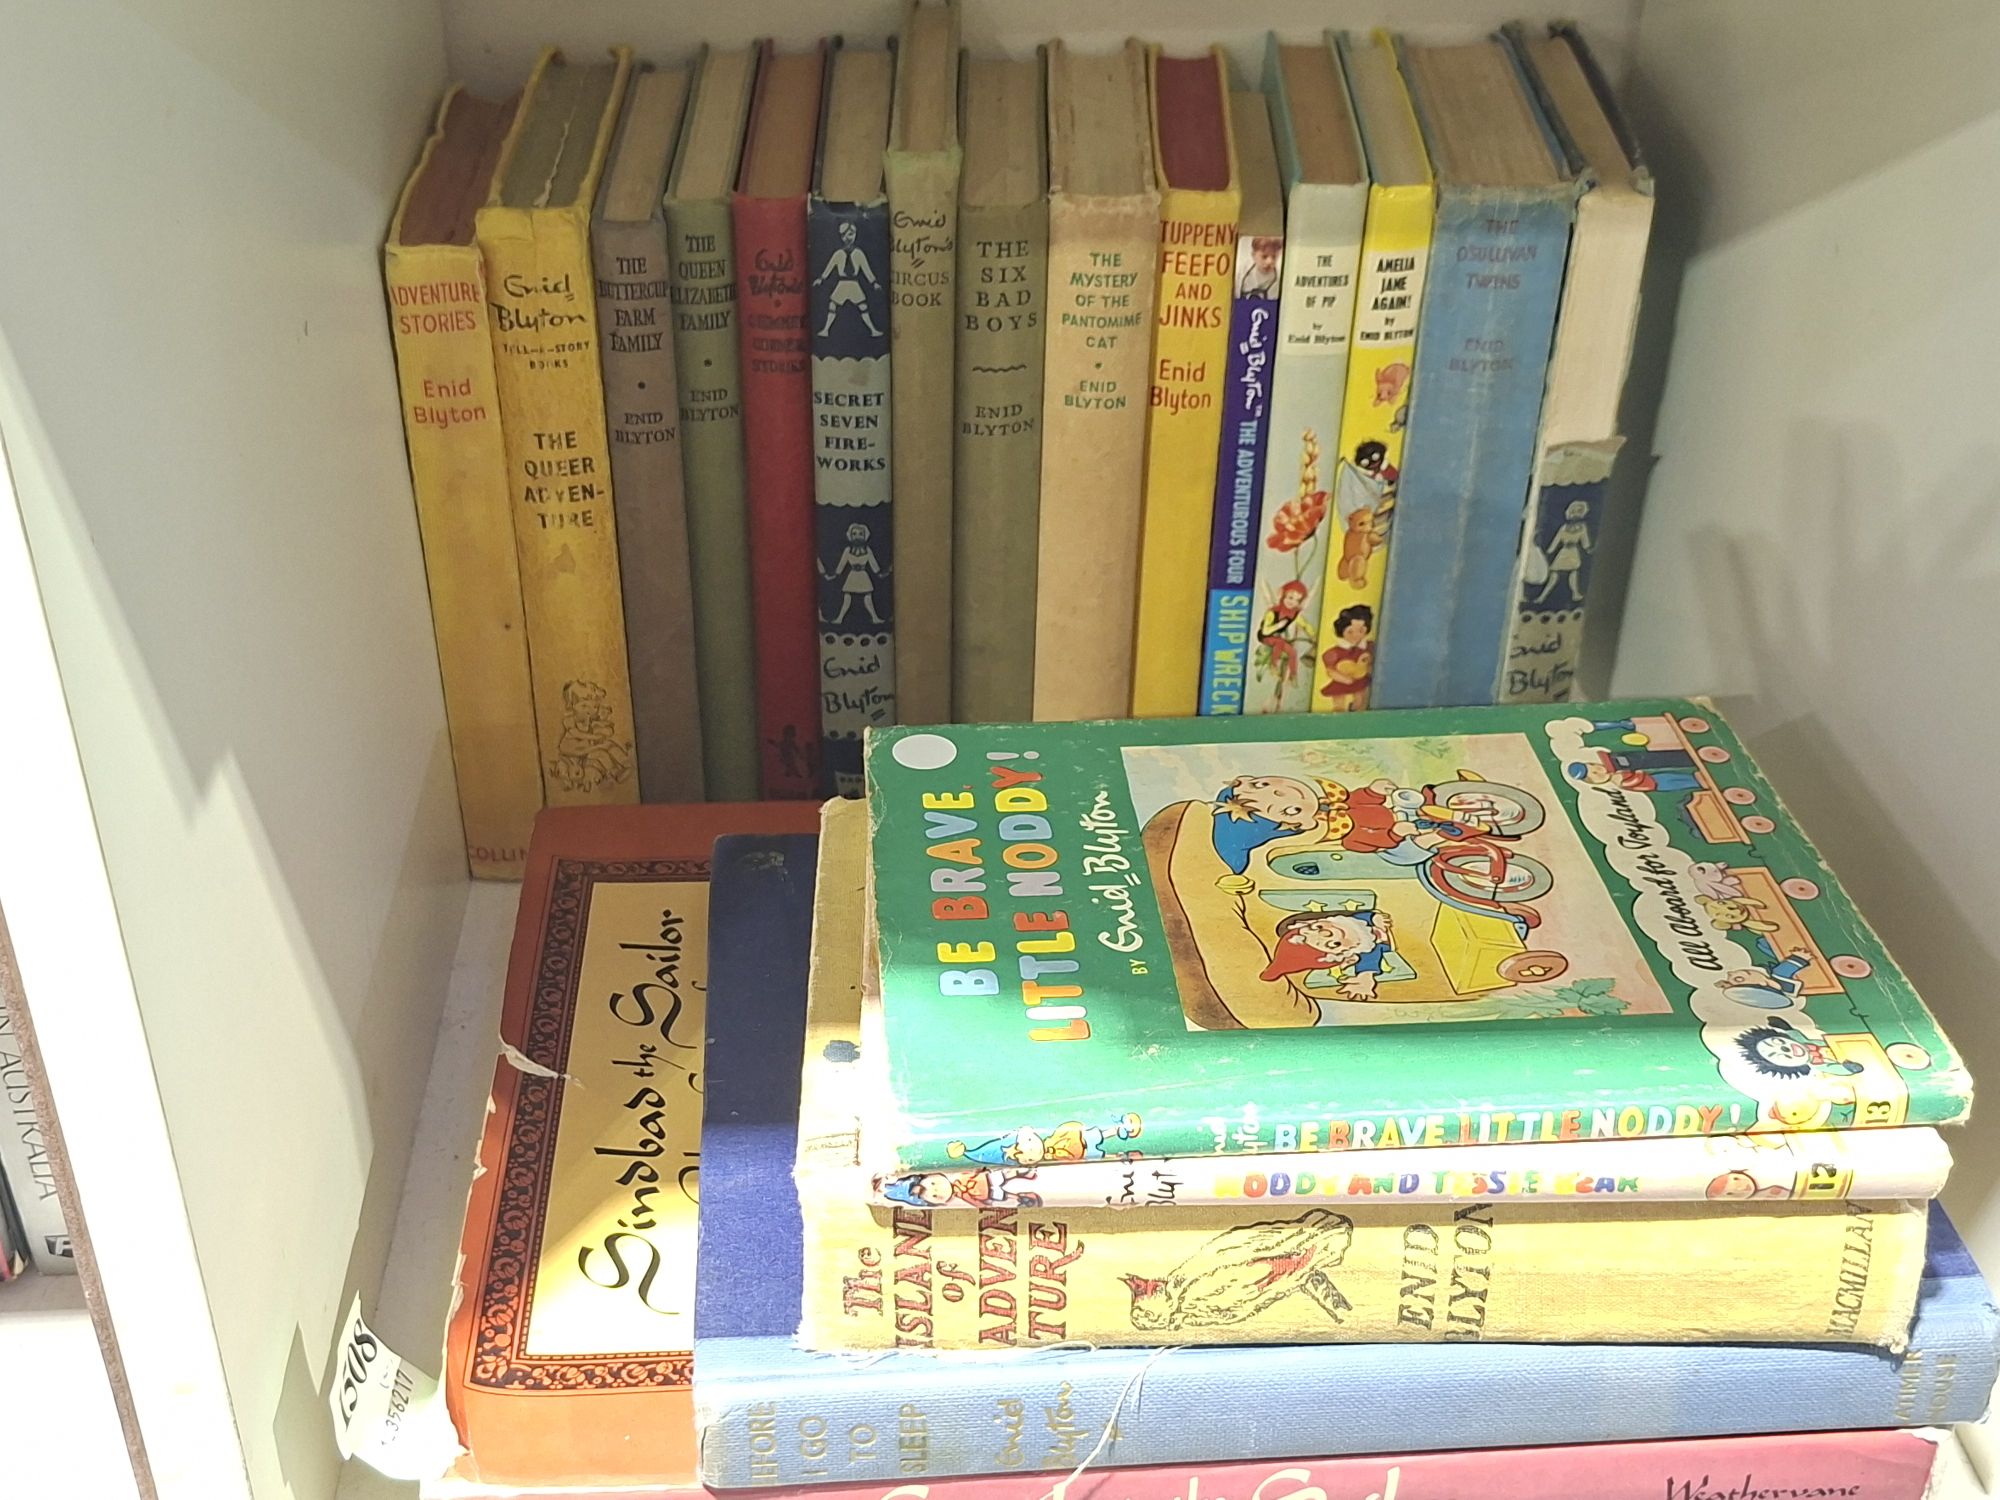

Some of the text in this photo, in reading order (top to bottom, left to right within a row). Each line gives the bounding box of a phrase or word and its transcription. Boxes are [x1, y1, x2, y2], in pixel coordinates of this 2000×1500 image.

[894, 209, 946, 229] Enid
[685, 234, 716, 253] THE
[1160, 220, 1237, 247] TUPPENY
[977, 240, 1029, 258] THE
[1089, 252, 1122, 267] THE
[616, 256, 647, 275] THE
[678, 259, 727, 281] QUEEN
[1161, 251, 1230, 276] FEEFO
[1317, 255, 1332, 268] THE
[1376, 257, 1415, 273] AMELIA
[892, 271, 950, 286] IRCUS
[981, 265, 1027, 284] SIX
[1069, 272, 1138, 288] MYSTERY
[1294, 274, 1349, 288] ADVENTURES
[1380, 276, 1408, 294] JANE
[503, 273, 570, 298] Enid
[598, 280, 669, 301] BUTTERCUP
[1175, 283, 1212, 301] AND
[892, 291, 942, 306] BOOK
[976, 290, 1031, 308] BAD
[1075, 294, 1130, 307] OF THE
[1305, 296, 1336, 308] OF PIP
[1371, 295, 1412, 311] AGAIN!
[400, 311, 476, 335] STORIES
[488, 302, 587, 332] Blyton
[615, 307, 656, 327] FARM
[679, 310, 732, 332] FAMILY
[965, 312, 1038, 333] BOYS
[1061, 312, 1142, 328] PANTOMIME
[1158, 305, 1222, 329] JINKS
[1384, 317, 1395, 327] by
[1248, 308, 1269, 349] Enid
[1360, 329, 1414, 341] ENID BLYTON
[608, 332, 664, 353] FAMILY
[1085, 335, 1118, 349] CAT
[1288, 334, 1345, 345] Enid Blyton
[1158, 358, 1206, 383] Enid
[1241, 351, 1266, 410] Blyton
[424, 378, 471, 398] Enid
[690, 388, 728, 402] ENID
[1079, 380, 1117, 393] ENID
[814, 392, 885, 408] SECRET
[1064, 395, 1127, 409] BLYTON
[1150, 385, 1212, 416] Blyton
[413, 406, 487, 429] Blyton
[624, 412, 663, 425] ENID
[680, 404, 740, 423] BLYTON
[820, 414, 879, 429] SEVEN
[976, 404, 1023, 419] ENID
[615, 427, 677, 445] BLYTON
[962, 417, 1034, 436] BLYTON
[534, 430, 578, 450] THE
[824, 436, 875, 451] FIRE-
[524, 456, 595, 480] QUEER
[816, 456, 886, 472] WORKS
[1226, 420, 1257, 585] THE ADVENTUROUS FOUR
[537, 509, 594, 529] TURE
[1219, 595, 1249, 643] SHIP
[824, 655, 881, 679] Enid
[824, 686, 895, 713] Blyton
[1079, 790, 1149, 976] BY Enid Blyton
[1591, 786, 1723, 971] All Aboard for Toyland
[985, 750, 1091, 1042] LITTLE NODDY!
[609, 908, 698, 1049] Sailor
[937, 941, 1000, 996] BE
[611, 1043, 662, 1077] the
[1865, 1100, 1891, 1125] 13
[1273, 1122, 1320, 1152] BE
[1457, 1108, 1583, 1144] LITTLE
[1589, 1102, 1742, 1139] NODDY!
[1348, 1172, 1420, 1195] AND
[1809, 1163, 1838, 1190] 12
[843, 1247, 883, 1317] The
[936, 1261, 976, 1303] of
[1028, 1221, 1085, 1341] TURE
[1397, 1223, 1440, 1330] ENID
[748, 1400, 778, 1480] EFORE
[799, 1415, 829, 1461] GO
[849, 1422, 878, 1462] TO
[897, 1402, 930, 1474] SLEEP
[994, 1397, 1025, 1468] Enid
